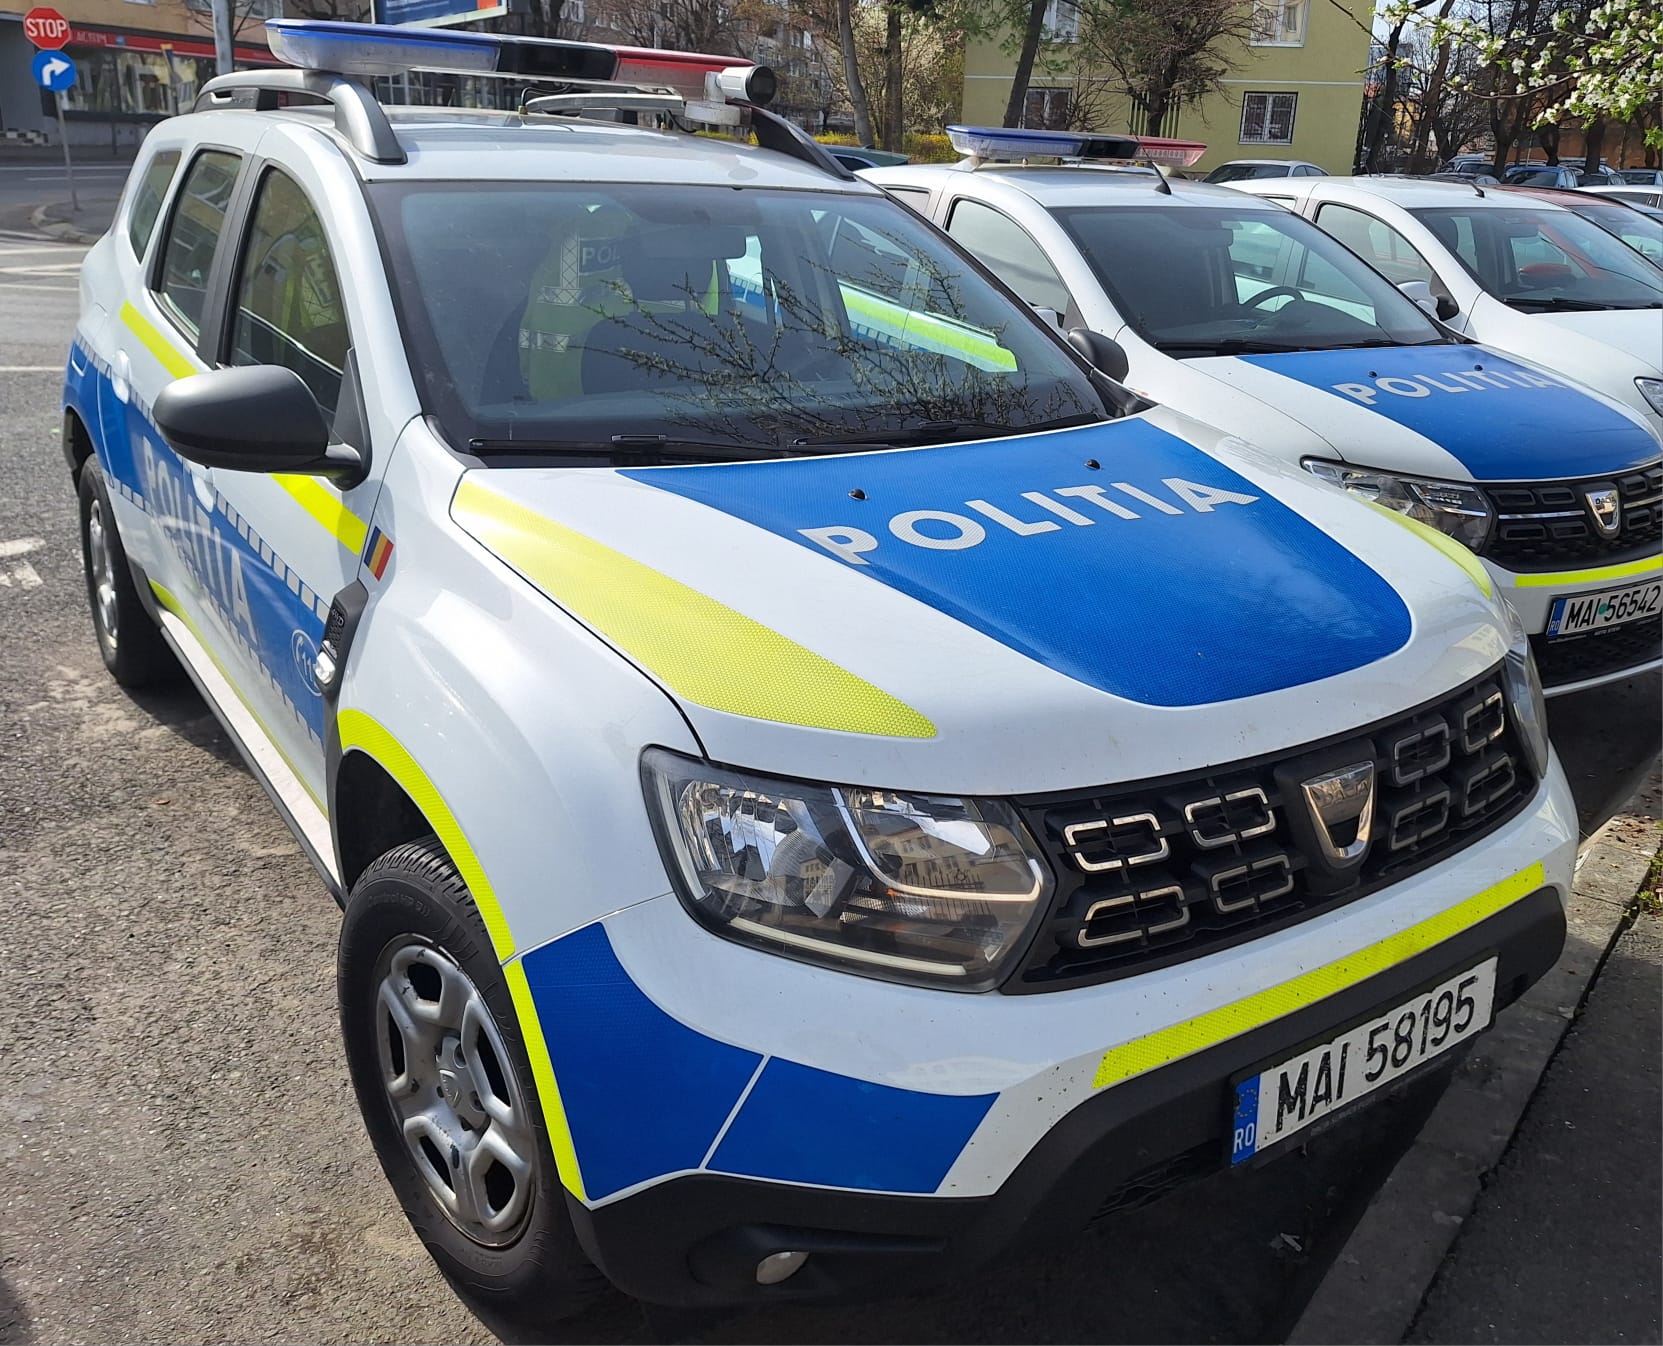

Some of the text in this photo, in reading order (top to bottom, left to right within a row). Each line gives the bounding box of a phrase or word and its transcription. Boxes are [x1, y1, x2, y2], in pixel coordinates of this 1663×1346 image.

[26, 18, 67, 38] STOP
[1331, 371, 1568, 405] POLITIA
[143, 436, 258, 646] POLITIA
[797, 477, 1260, 565] POLITIA
[1565, 585, 1660, 630] MAI 56542
[1276, 1042, 1350, 1134] MAI
[1365, 975, 1478, 1083] 58195
[1233, 1122, 1255, 1153] RO
